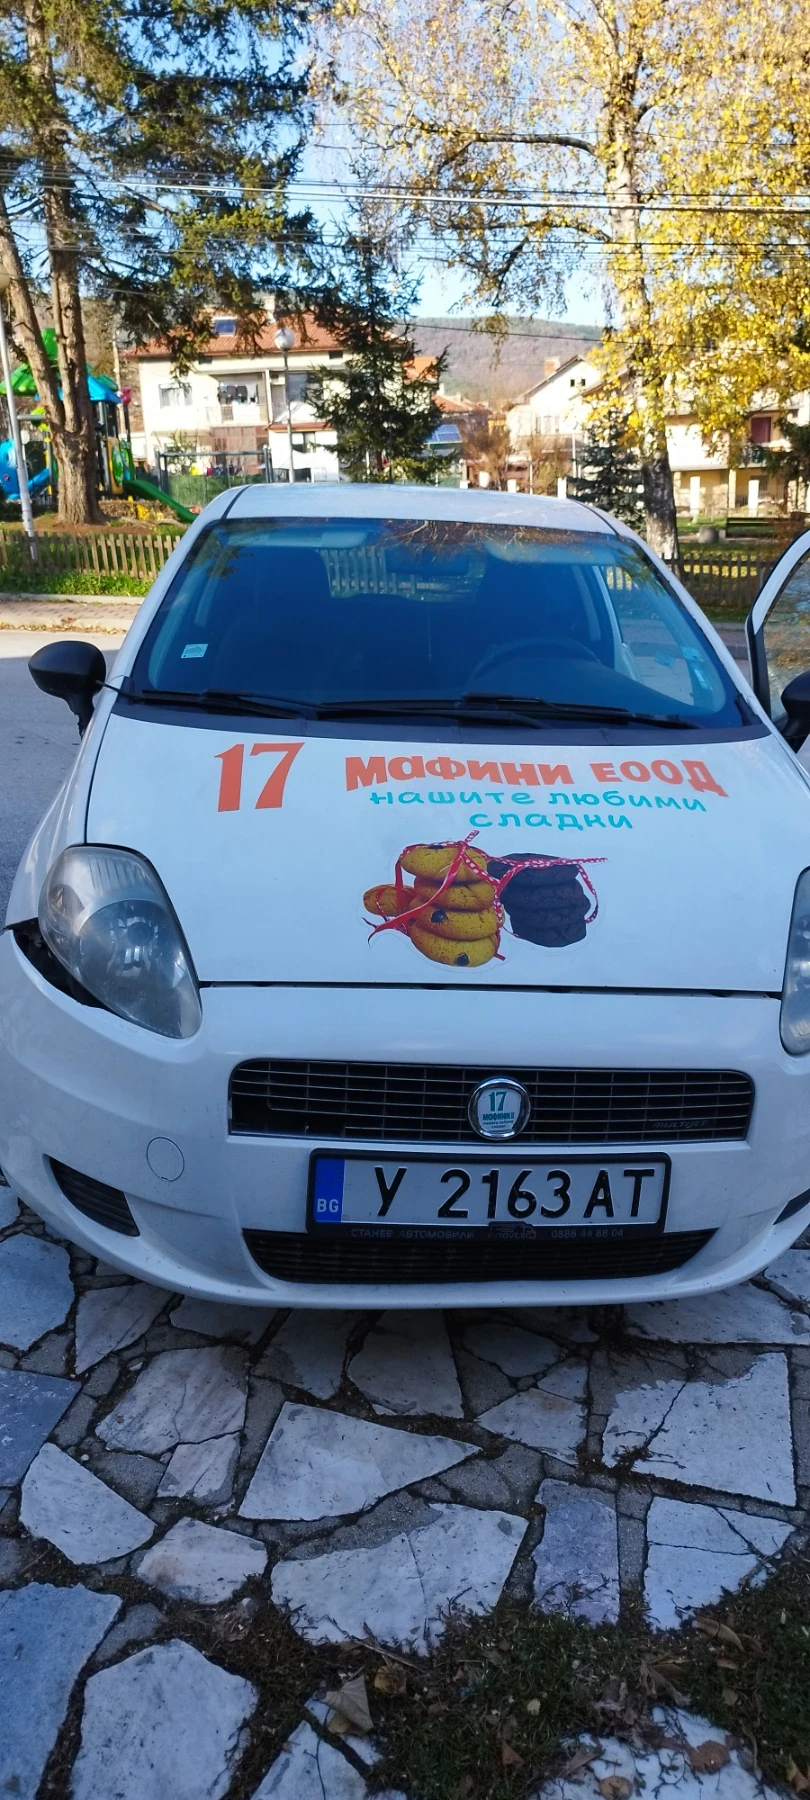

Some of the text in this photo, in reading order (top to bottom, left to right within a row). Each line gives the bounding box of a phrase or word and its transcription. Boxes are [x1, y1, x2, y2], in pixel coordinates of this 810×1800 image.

[214, 742, 304, 812] 17
[589, 758, 729, 798] ЕООД
[369, 789, 708, 812] нашите любими
[468, 811, 634, 831] сладки
[488, 1091, 508, 1112] 17
[437, 1168, 572, 1219] 2163
[316, 1198, 340, 1213] BG
[350, 1228, 394, 1239] СТАНЕВ
